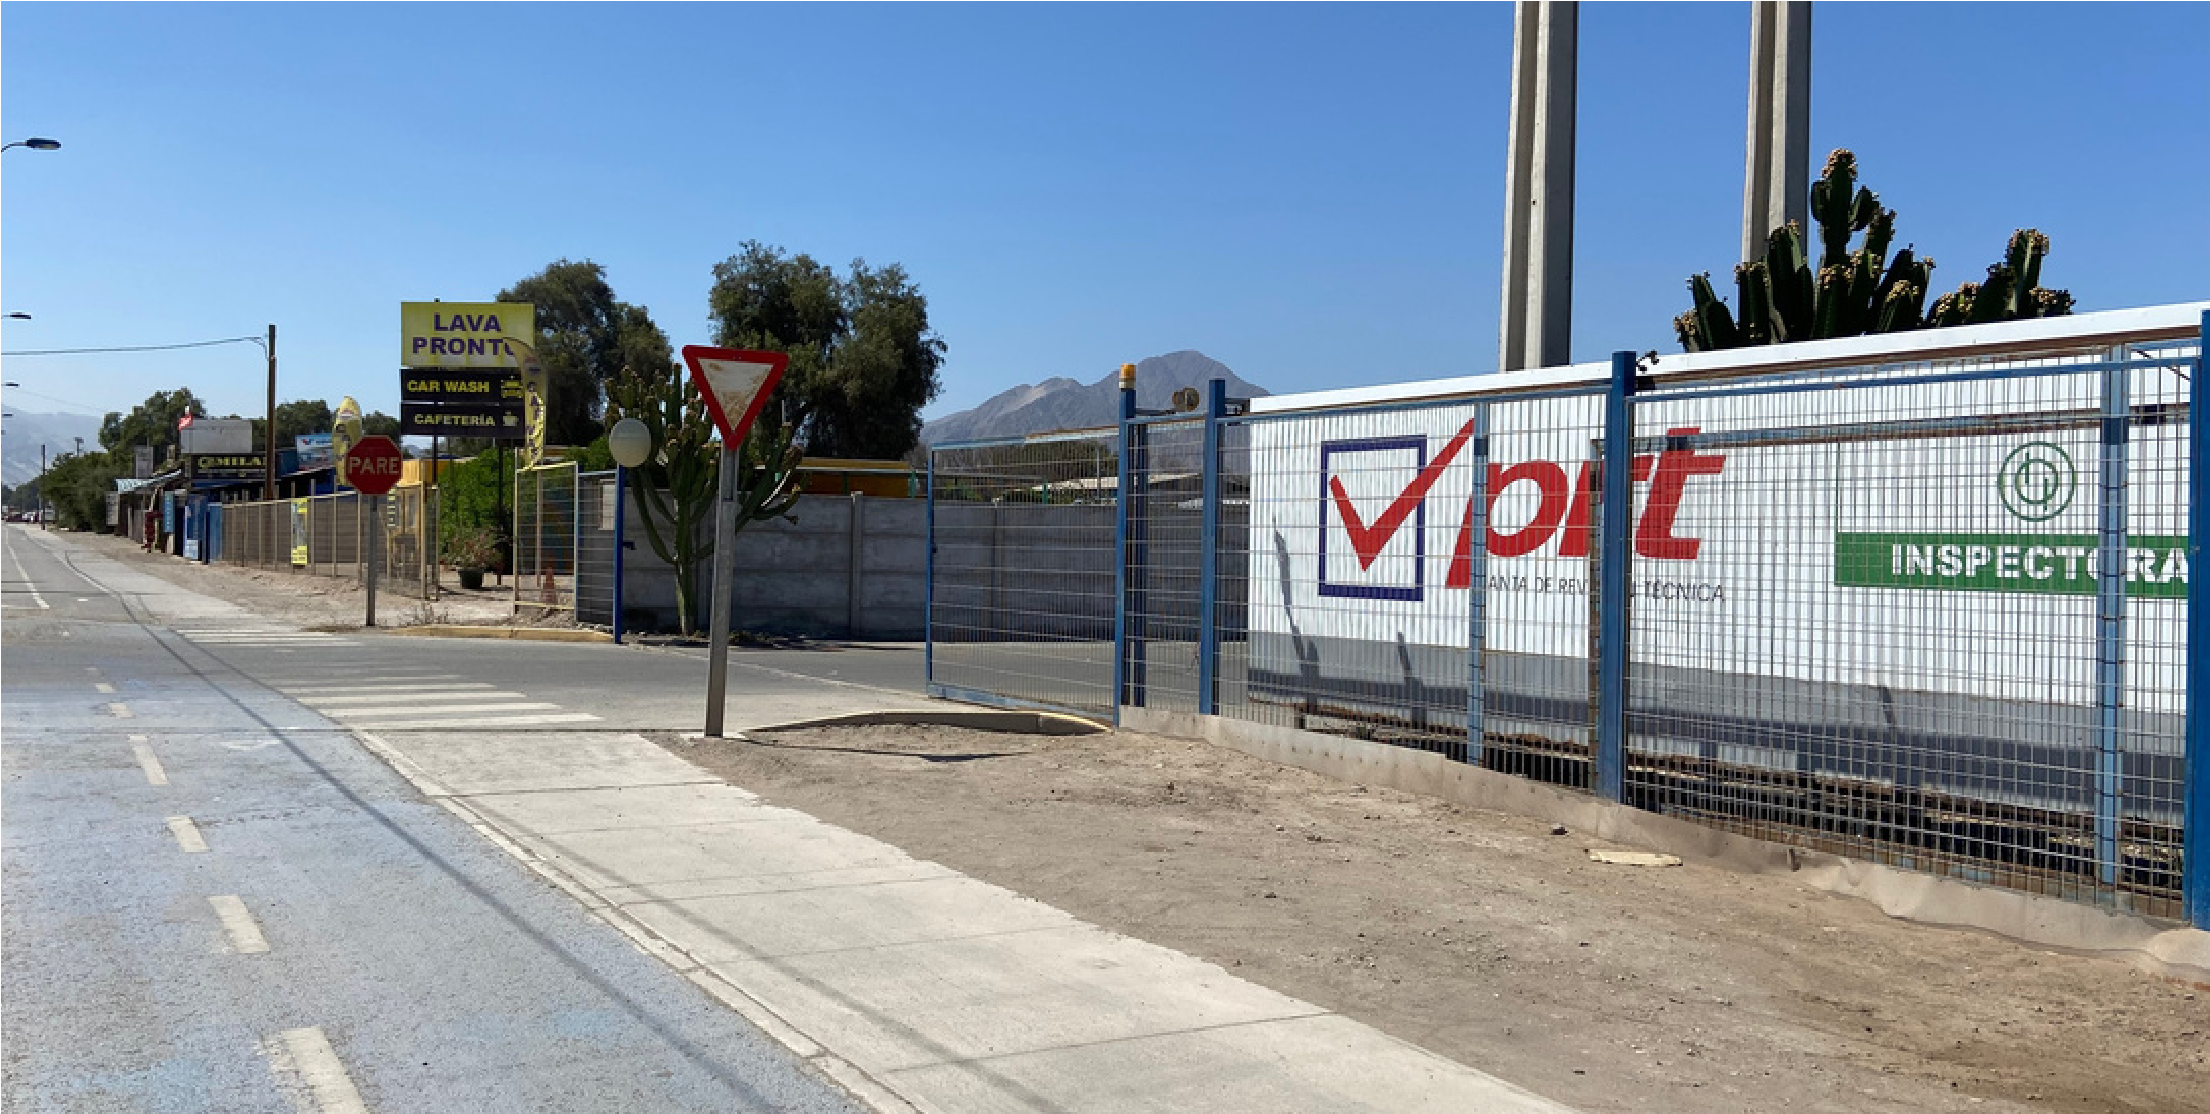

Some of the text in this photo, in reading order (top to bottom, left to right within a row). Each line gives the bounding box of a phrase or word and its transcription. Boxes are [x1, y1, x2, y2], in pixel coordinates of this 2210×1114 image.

[433, 313, 501, 332] LAVA
[406, 380, 490, 393] CAR WASH
[414, 413, 496, 427] CAFETERÍA
[348, 455, 401, 475] PARE
